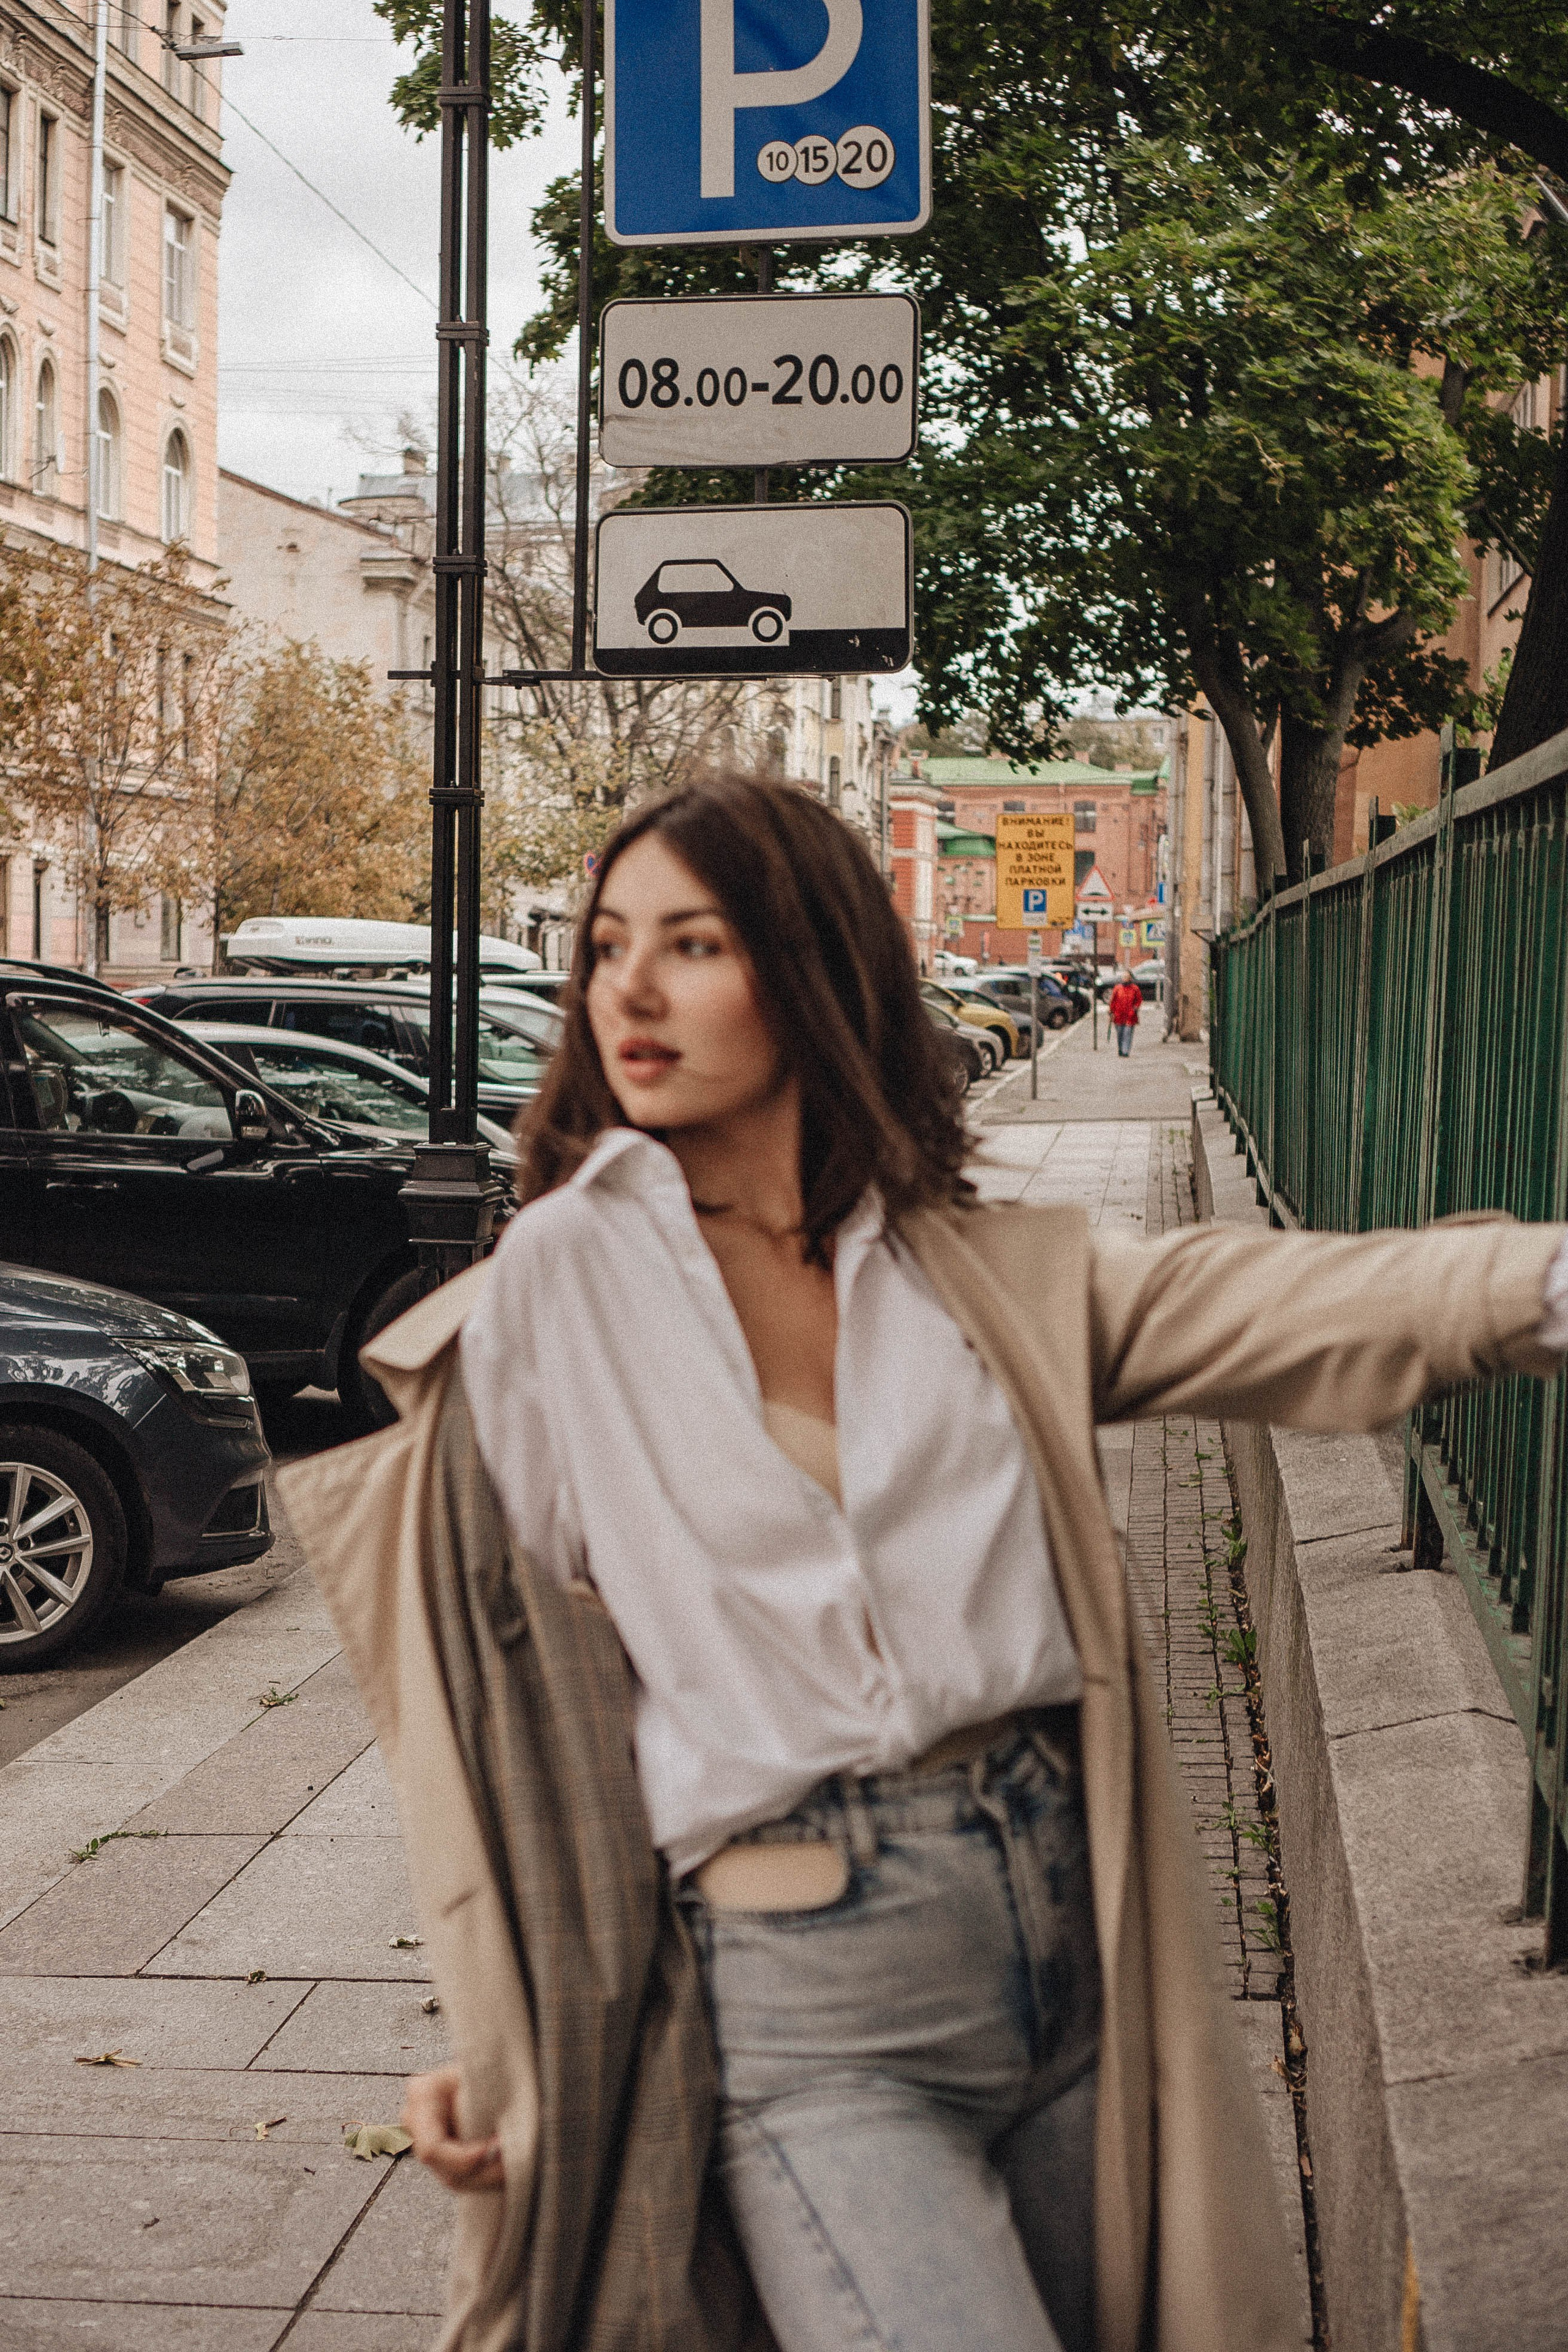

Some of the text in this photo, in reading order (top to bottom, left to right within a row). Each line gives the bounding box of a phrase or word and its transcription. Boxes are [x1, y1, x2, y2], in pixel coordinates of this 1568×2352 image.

[700, 0, 864, 198] P
[766, 138, 888, 175] 10 15 20
[618, 353, 904, 409] 08.00-20.00
[1027, 829, 1045, 837] ВЫ
[998, 840, 1073, 850] НАХОДИТЕСЬ
[1016, 853, 1054, 862] В ЗОНЕ
[1009, 863, 1062, 874] ПЛАТНОЙ
[1005, 876, 1066, 886] ПАРКОВКИ
[1028, 890, 1044, 911] P
